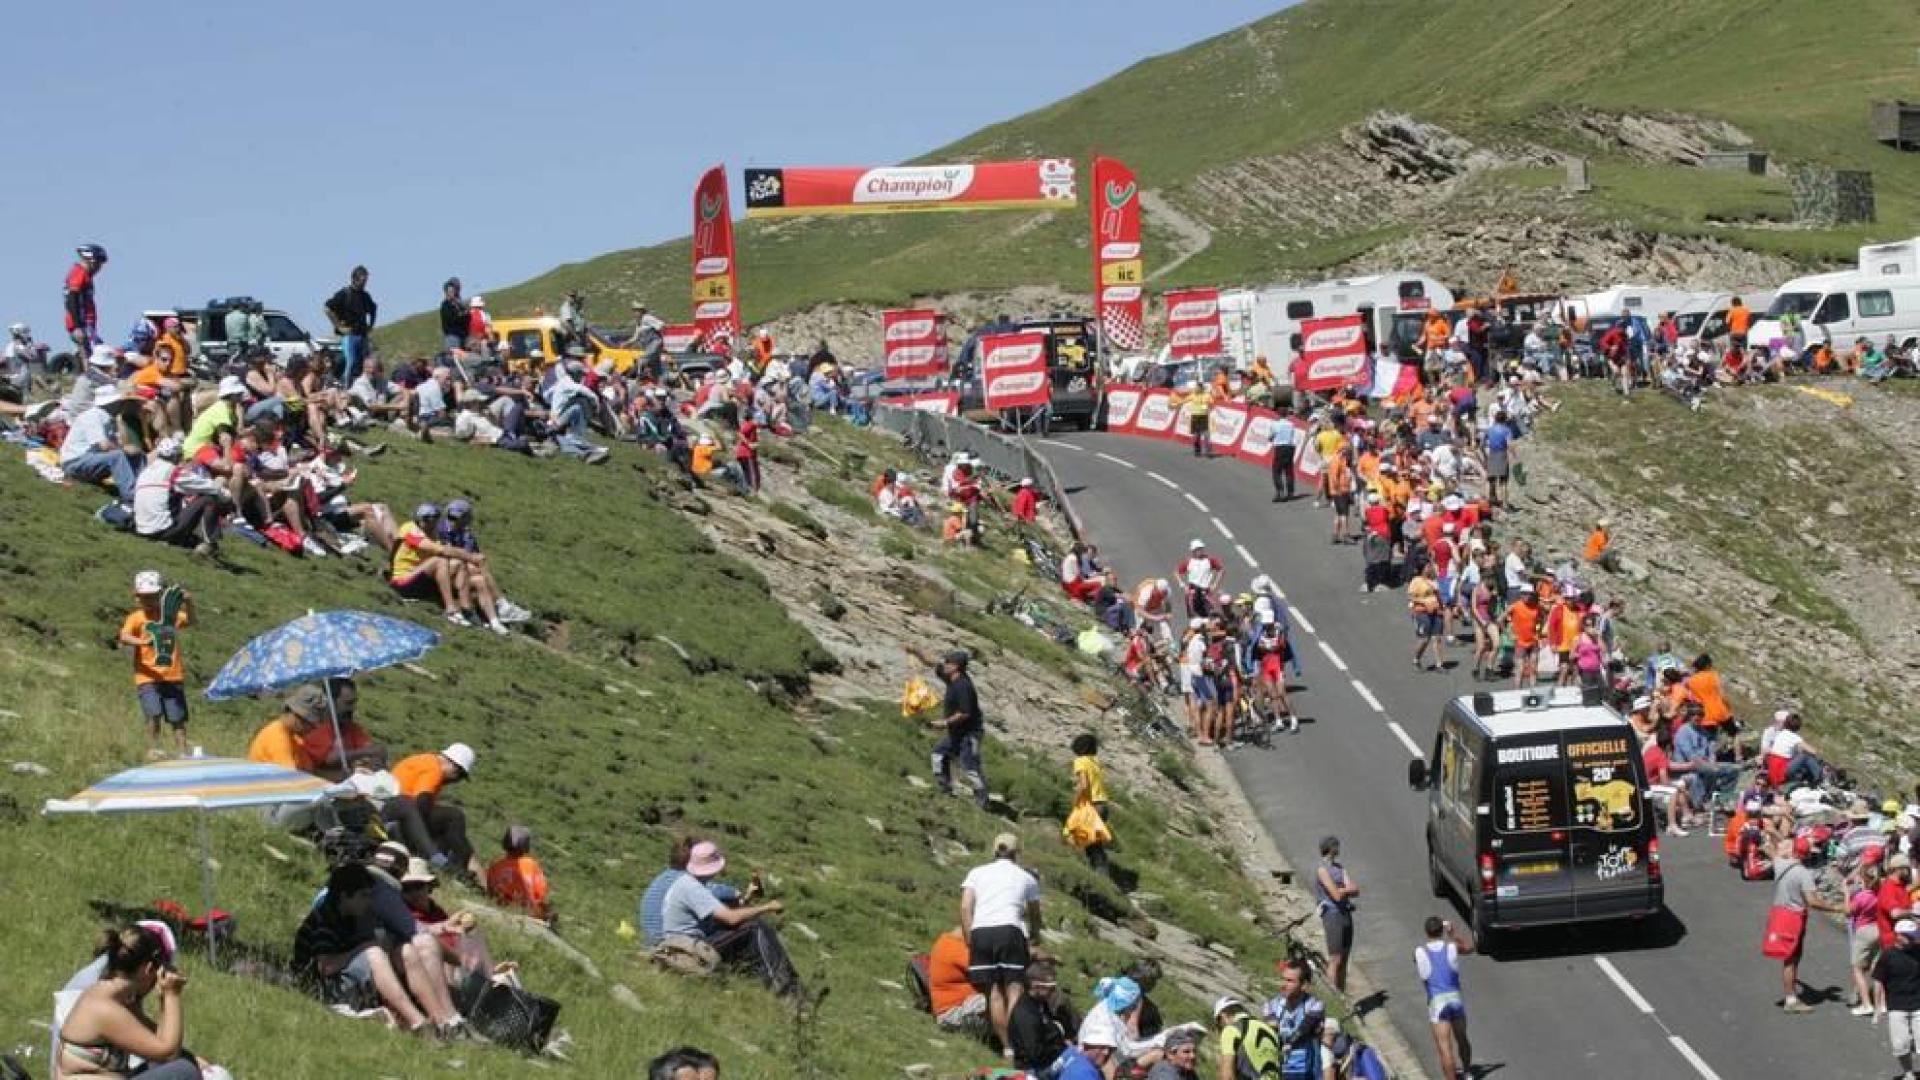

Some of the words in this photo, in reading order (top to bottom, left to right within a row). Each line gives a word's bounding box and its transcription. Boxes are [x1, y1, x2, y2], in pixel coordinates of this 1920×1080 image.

[868, 177, 953, 195] Champion
[1118, 270, 1135, 282] HC
[1498, 745, 1558, 763] BOUTIQUE
[1568, 740, 1627, 757] OFFICIELLE
